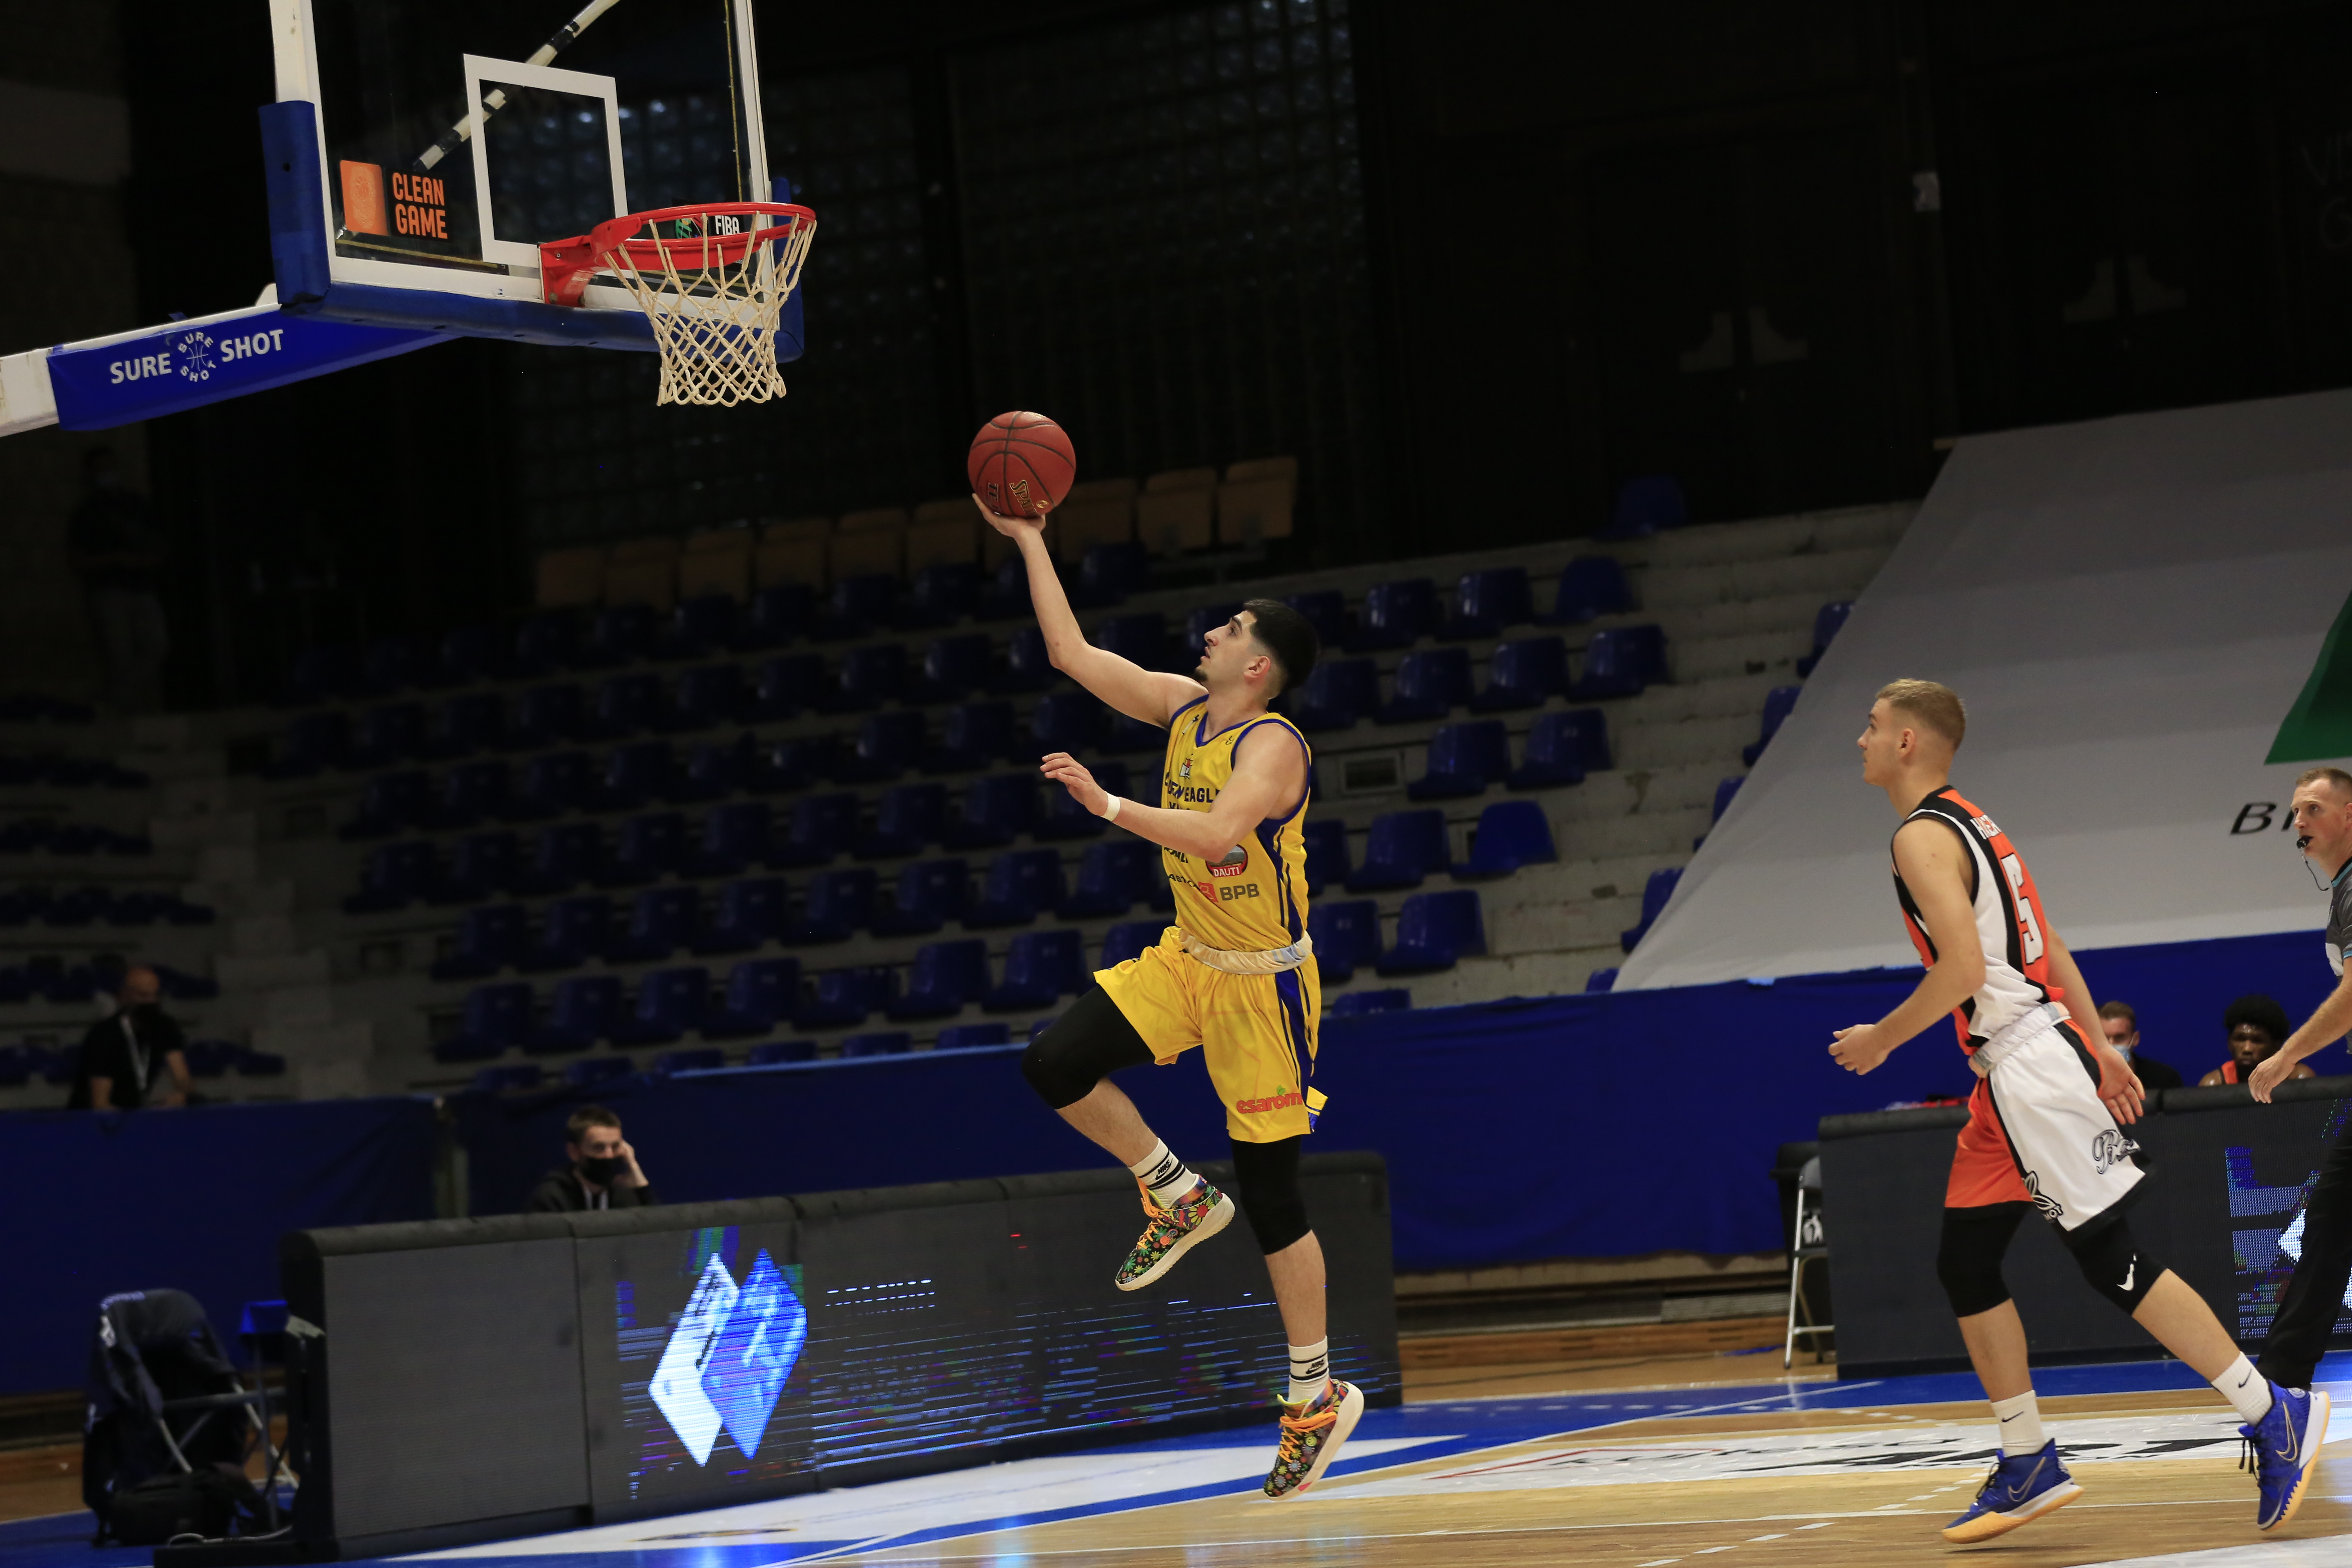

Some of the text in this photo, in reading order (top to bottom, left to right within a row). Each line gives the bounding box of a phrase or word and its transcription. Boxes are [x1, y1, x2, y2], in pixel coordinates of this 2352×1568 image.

[392, 172, 445, 206] CLEAN
[395, 203, 448, 239] GAME
[715, 215, 740, 236] FIBA
[178, 331, 214, 353] SURE
[109, 329, 284, 384] SURE SHOT
[180, 360, 217, 382] SHOT
[1213, 866, 1240, 877] DAUTI
[1220, 883, 1259, 901] BPB
[2001, 853, 2043, 965] 5
[1236, 1092, 1303, 1114] esarom
[1157, 1159, 1170, 1175] NIKE
